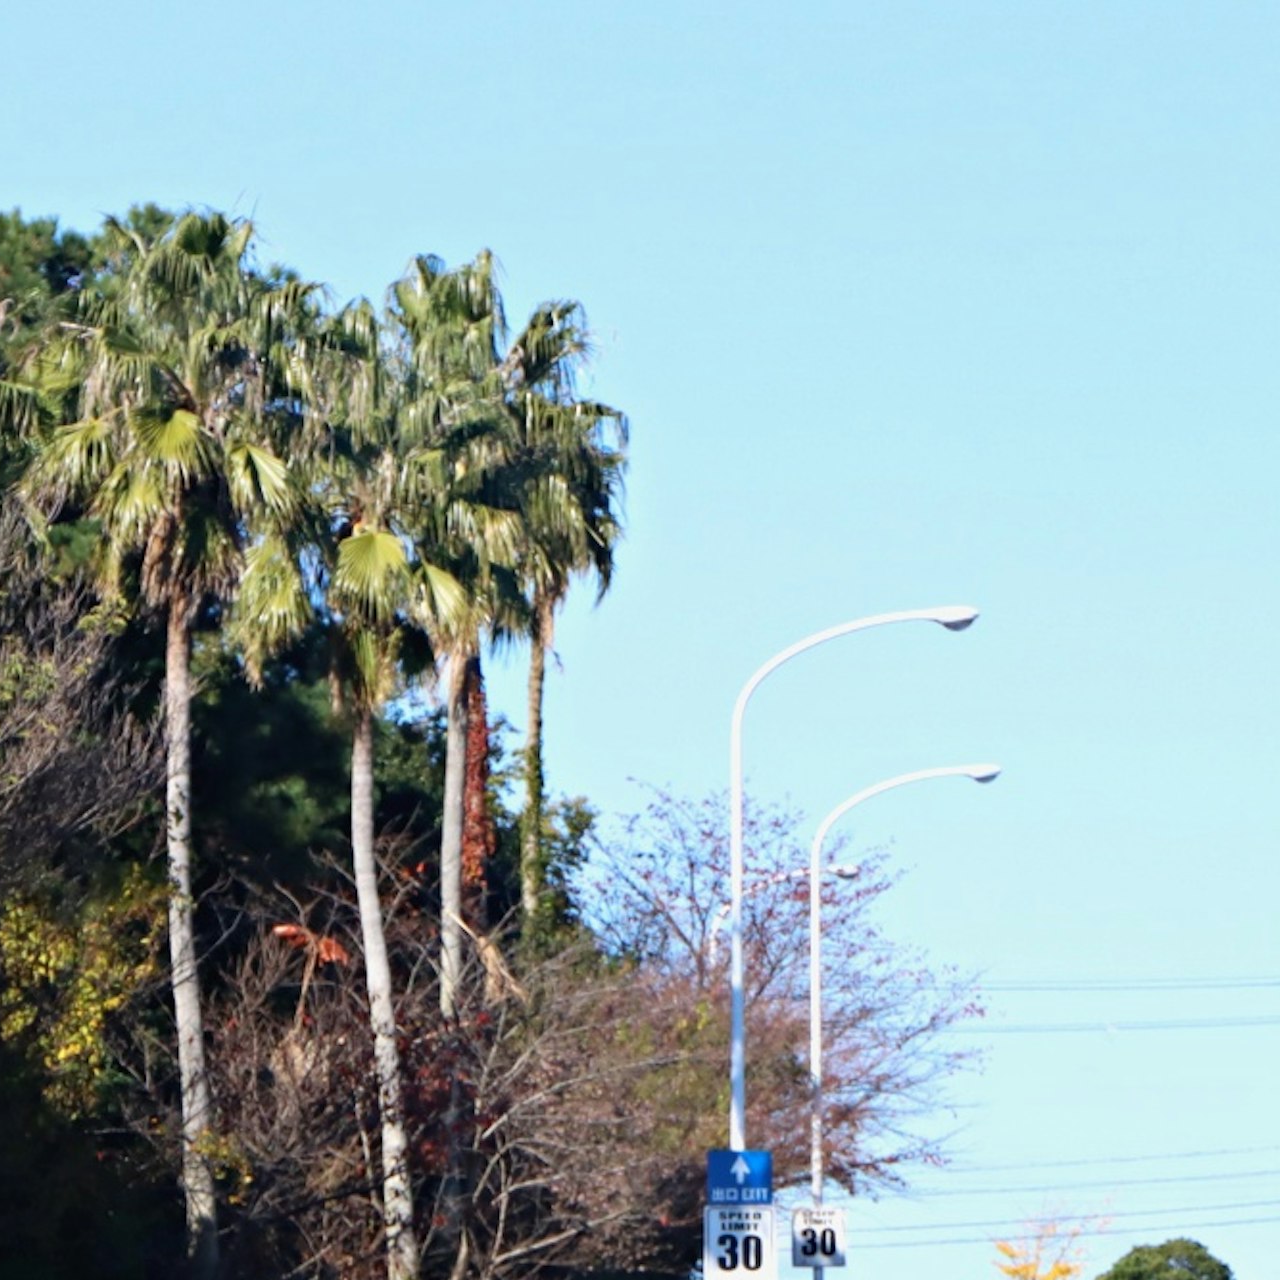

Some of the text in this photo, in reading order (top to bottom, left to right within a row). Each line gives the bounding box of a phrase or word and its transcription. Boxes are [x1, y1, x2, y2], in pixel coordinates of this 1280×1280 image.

[712, 1187, 768, 1201] 出口 EXIT
[719, 1211, 762, 1220] SPEED
[722, 1222, 759, 1231] LIMIT
[801, 1228, 836, 1257] 30
[718, 1234, 762, 1271] 30
